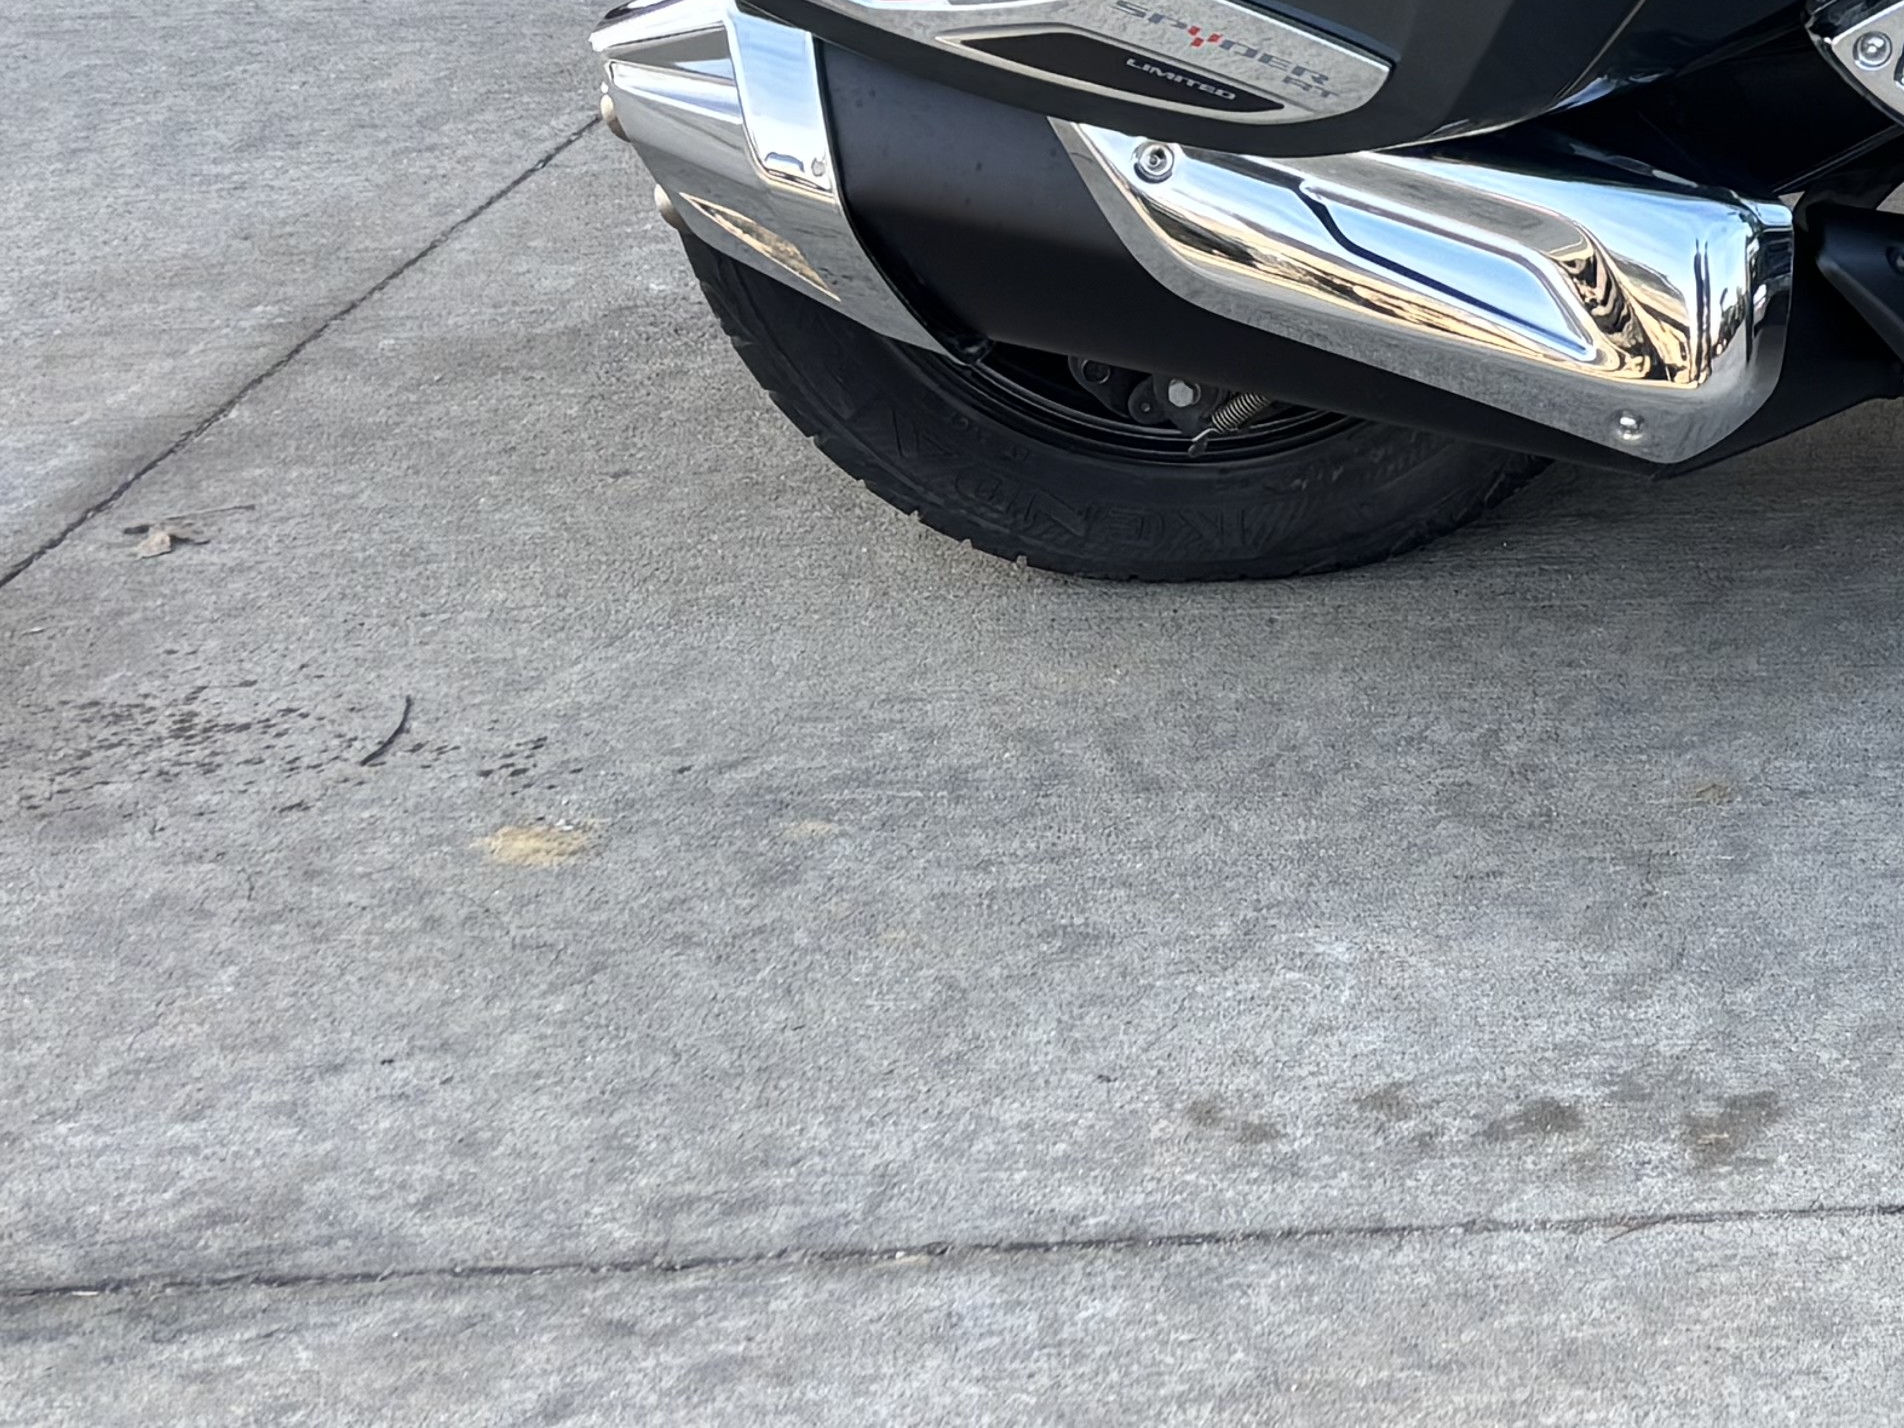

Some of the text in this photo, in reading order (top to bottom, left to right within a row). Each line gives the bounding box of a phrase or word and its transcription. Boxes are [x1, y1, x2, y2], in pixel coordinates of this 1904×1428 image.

[1111, 0, 1330, 85] SPYDER
[1125, 57, 1237, 101] LIMITED
[1282, 75, 1340, 100] RT
